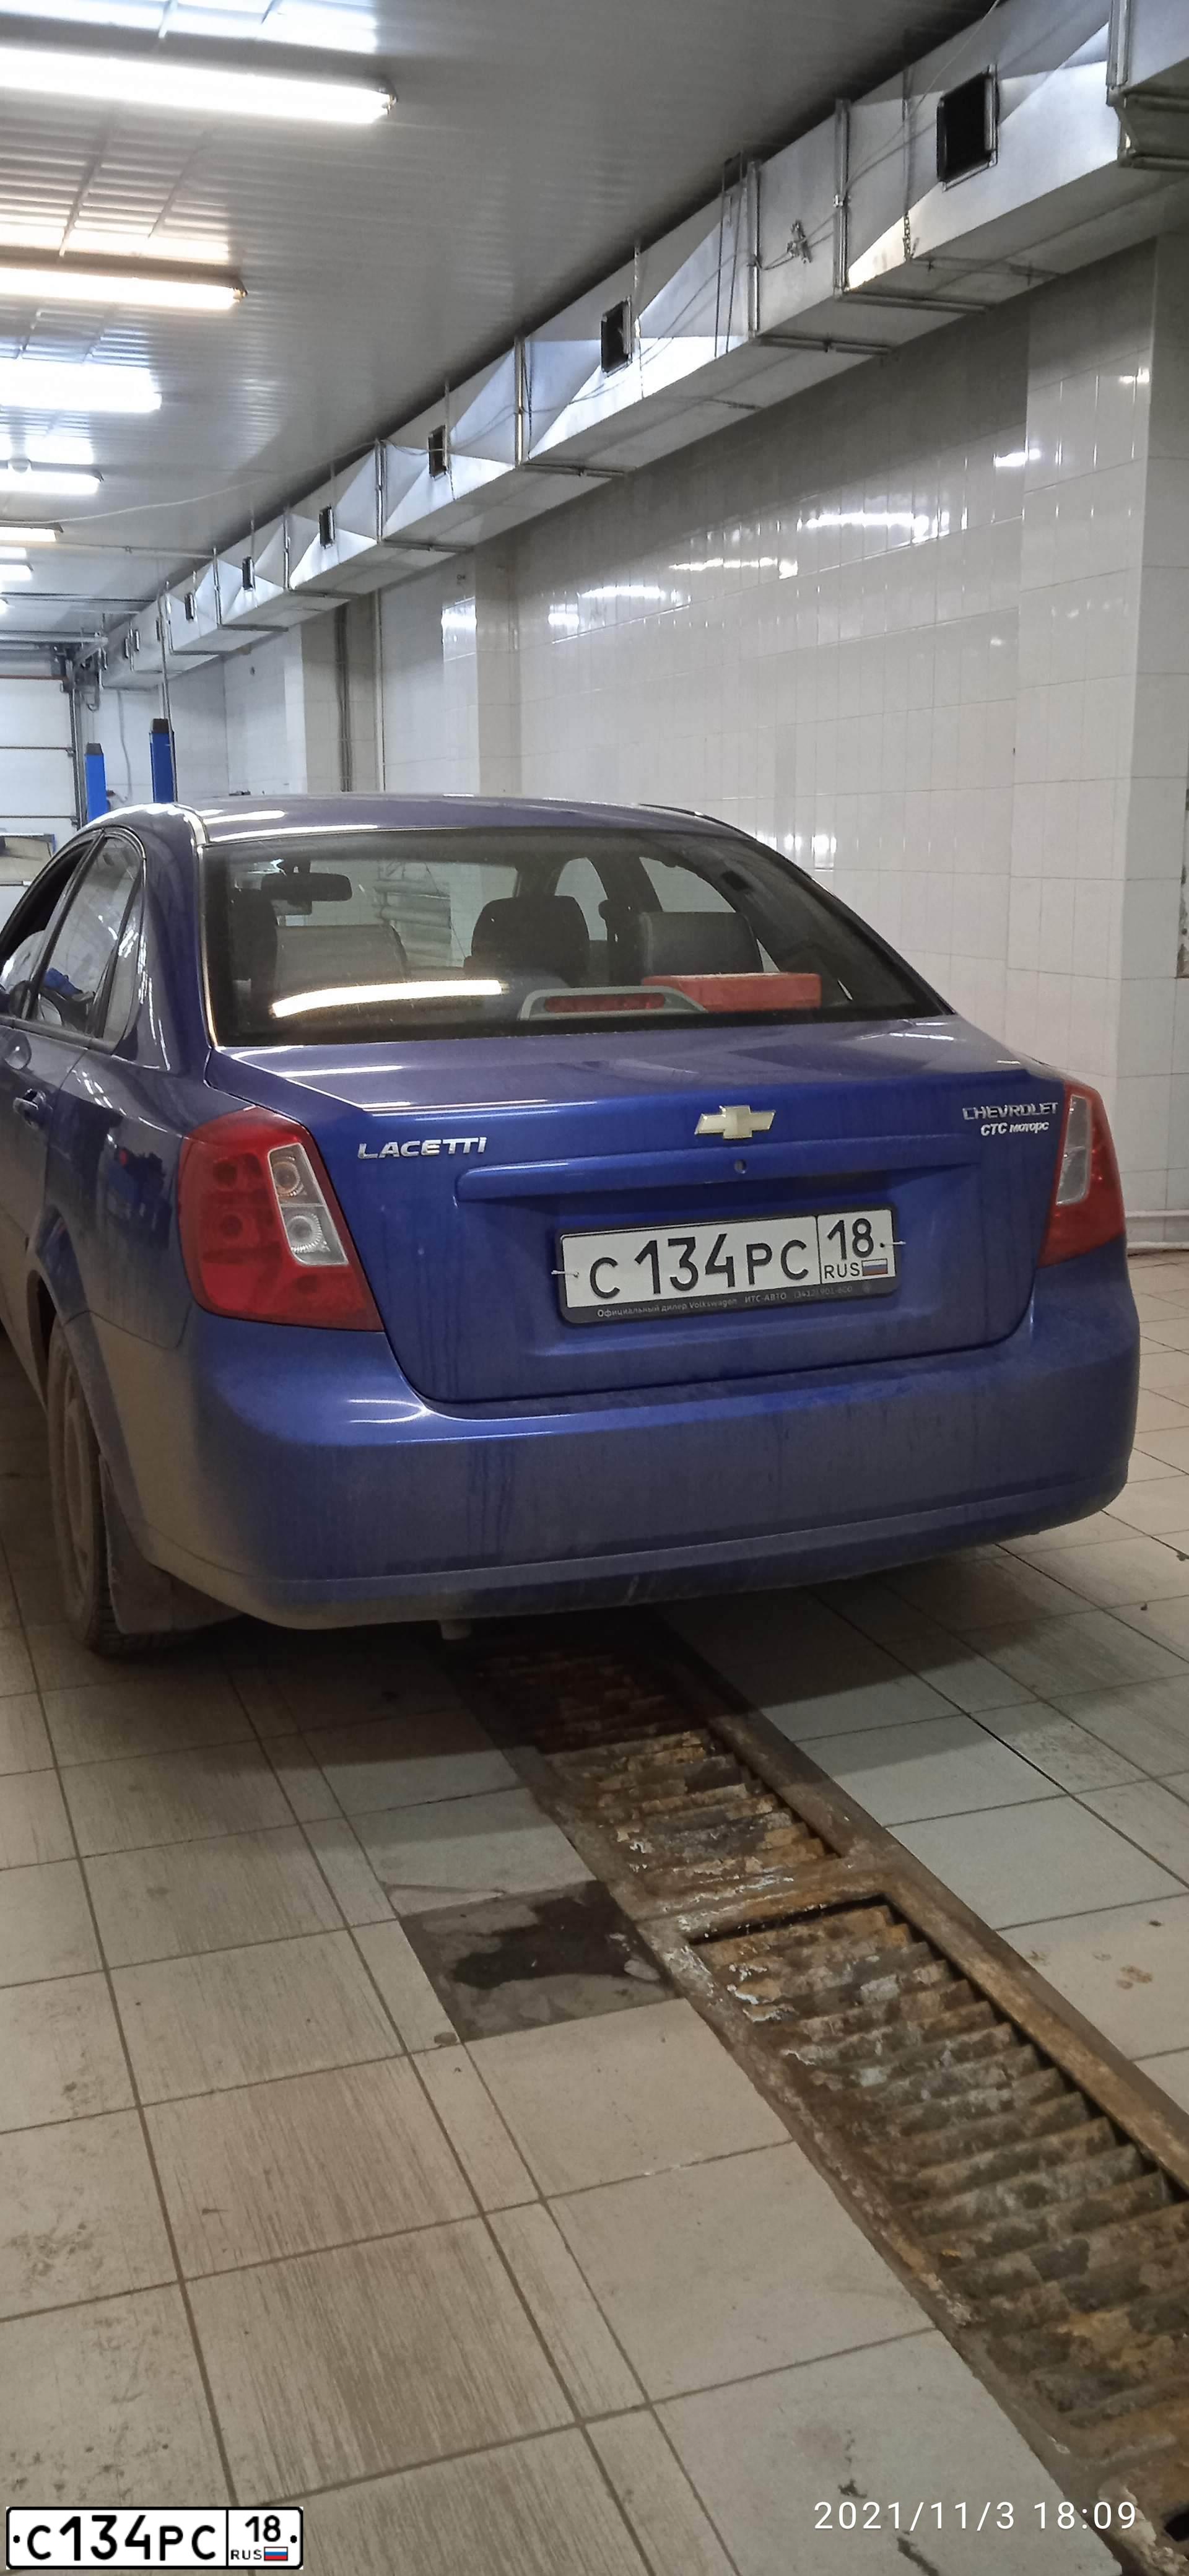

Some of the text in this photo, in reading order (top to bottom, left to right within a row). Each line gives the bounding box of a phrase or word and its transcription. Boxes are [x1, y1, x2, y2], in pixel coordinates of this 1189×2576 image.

[962, 1102, 1058, 1120] CHEVROLET
[980, 1122, 1008, 1136] СТС
[357, 1137, 487, 1159] LACETTI
[828, 1218, 874, 1260] 18
[824, 1262, 860, 1279] RUS
[597, 1305, 660, 1317] Официальный
[661, 1303, 687, 1312] дилер
[689, 1298, 737, 1309] Volkswagen
